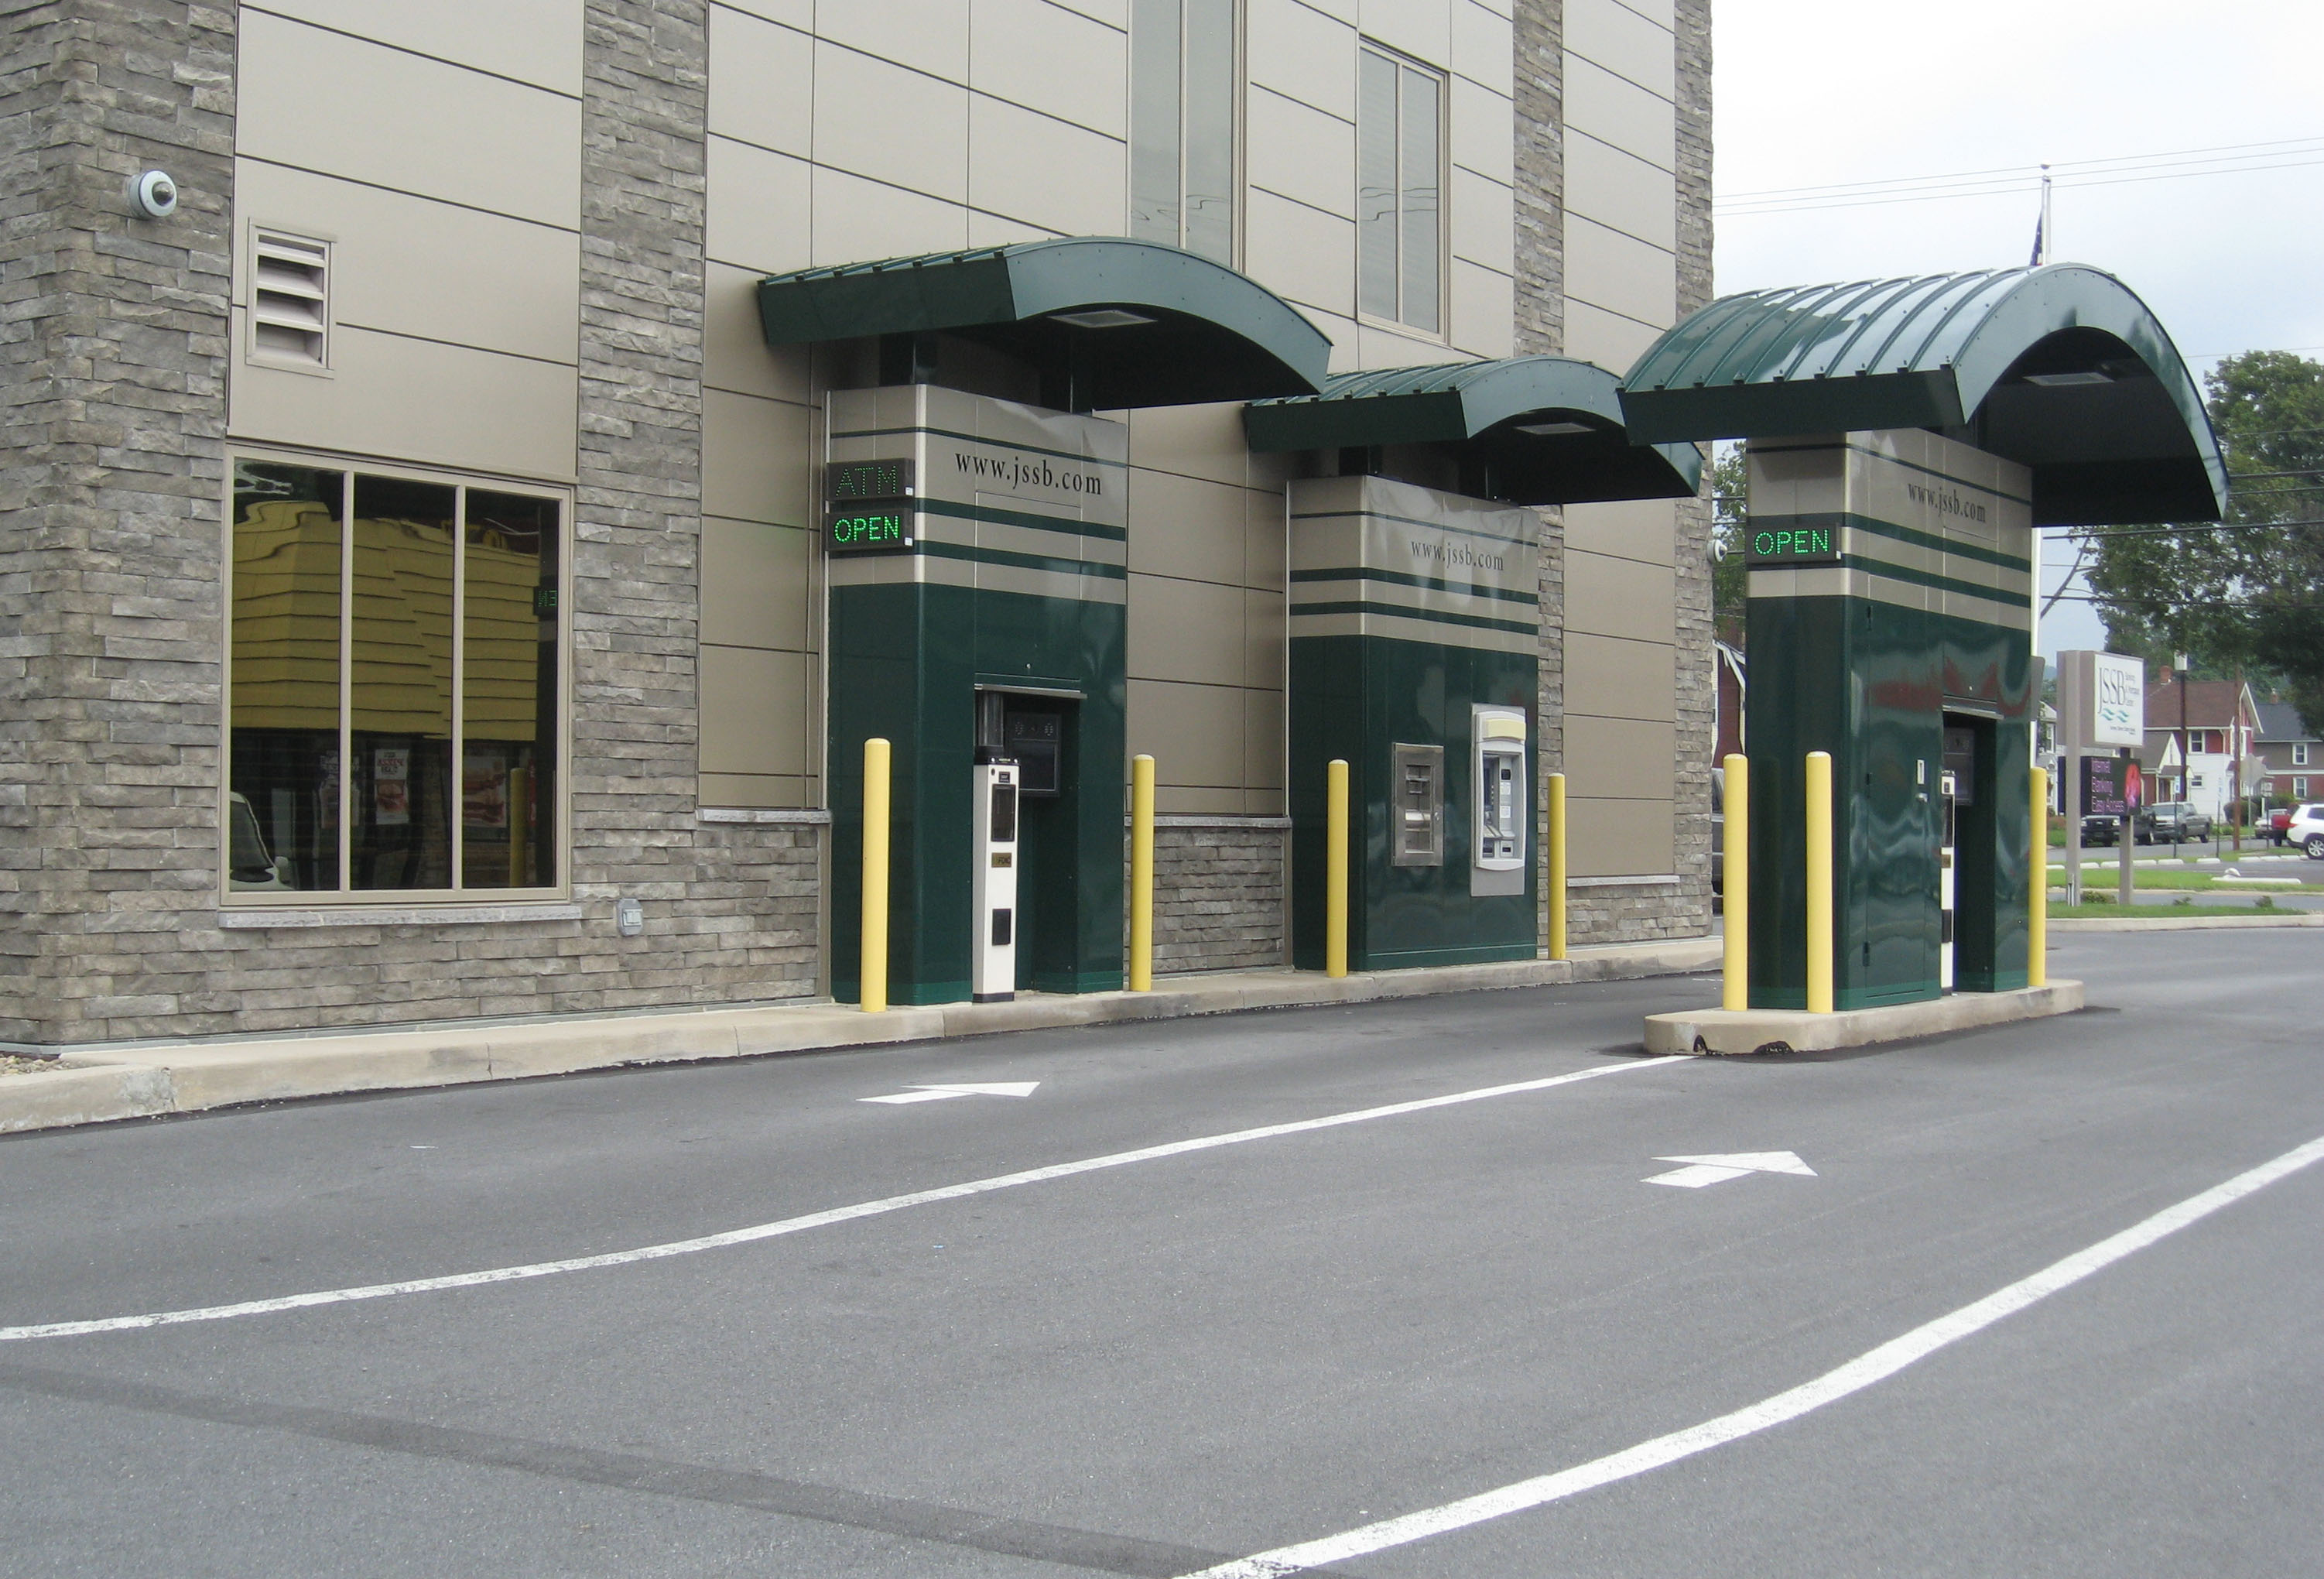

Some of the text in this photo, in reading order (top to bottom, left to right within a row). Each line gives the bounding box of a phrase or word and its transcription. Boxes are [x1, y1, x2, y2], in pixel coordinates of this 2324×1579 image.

[836, 465, 896, 496] ATM
[955, 453, 1102, 495] www.jssb.com
[1908, 483, 1986, 523] www.jssb.com
[834, 515, 899, 543] OPEN
[1754, 529, 1829, 555] OPEN
[1411, 541, 1504, 571] www.jssb.com
[2098, 667, 2125, 714] JSSB
